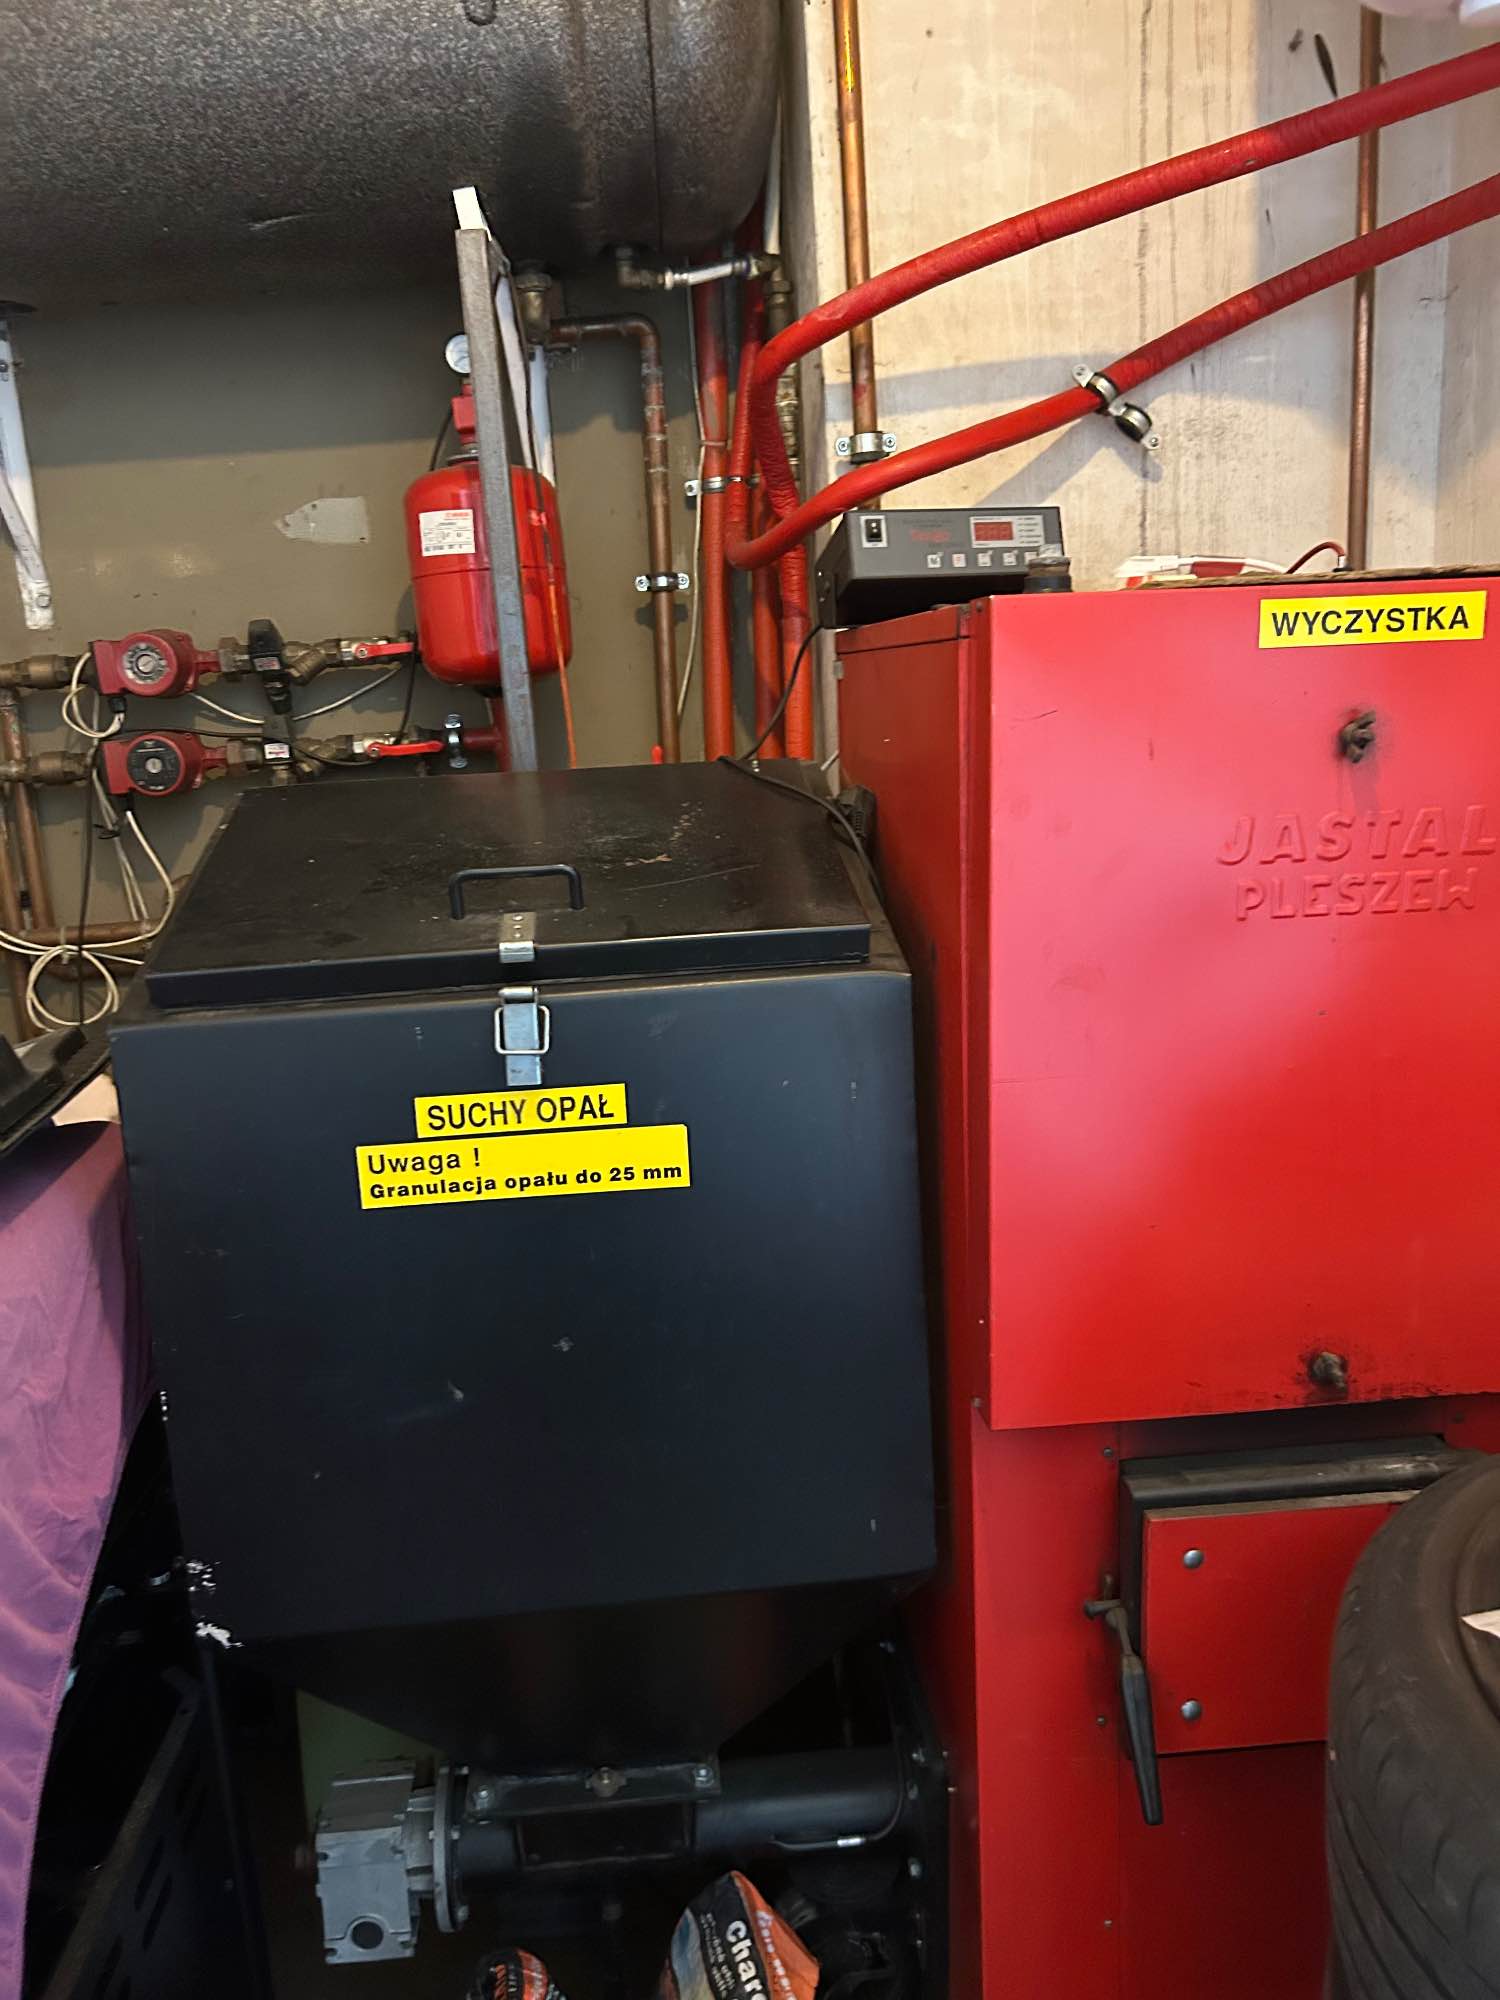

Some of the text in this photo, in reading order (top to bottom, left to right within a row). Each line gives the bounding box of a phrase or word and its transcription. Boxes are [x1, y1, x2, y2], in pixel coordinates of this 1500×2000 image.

[1271, 605, 1470, 637] WYCZYSTKA
[1216, 804, 1497, 866] JASTAL
[1236, 867, 1479, 922] PLESZEW
[427, 1094, 615, 1131] SUCHY OPAŁ
[367, 1148, 482, 1176] Uwaga !
[369, 1164, 683, 1199] Granulacja opału do 25 mm
